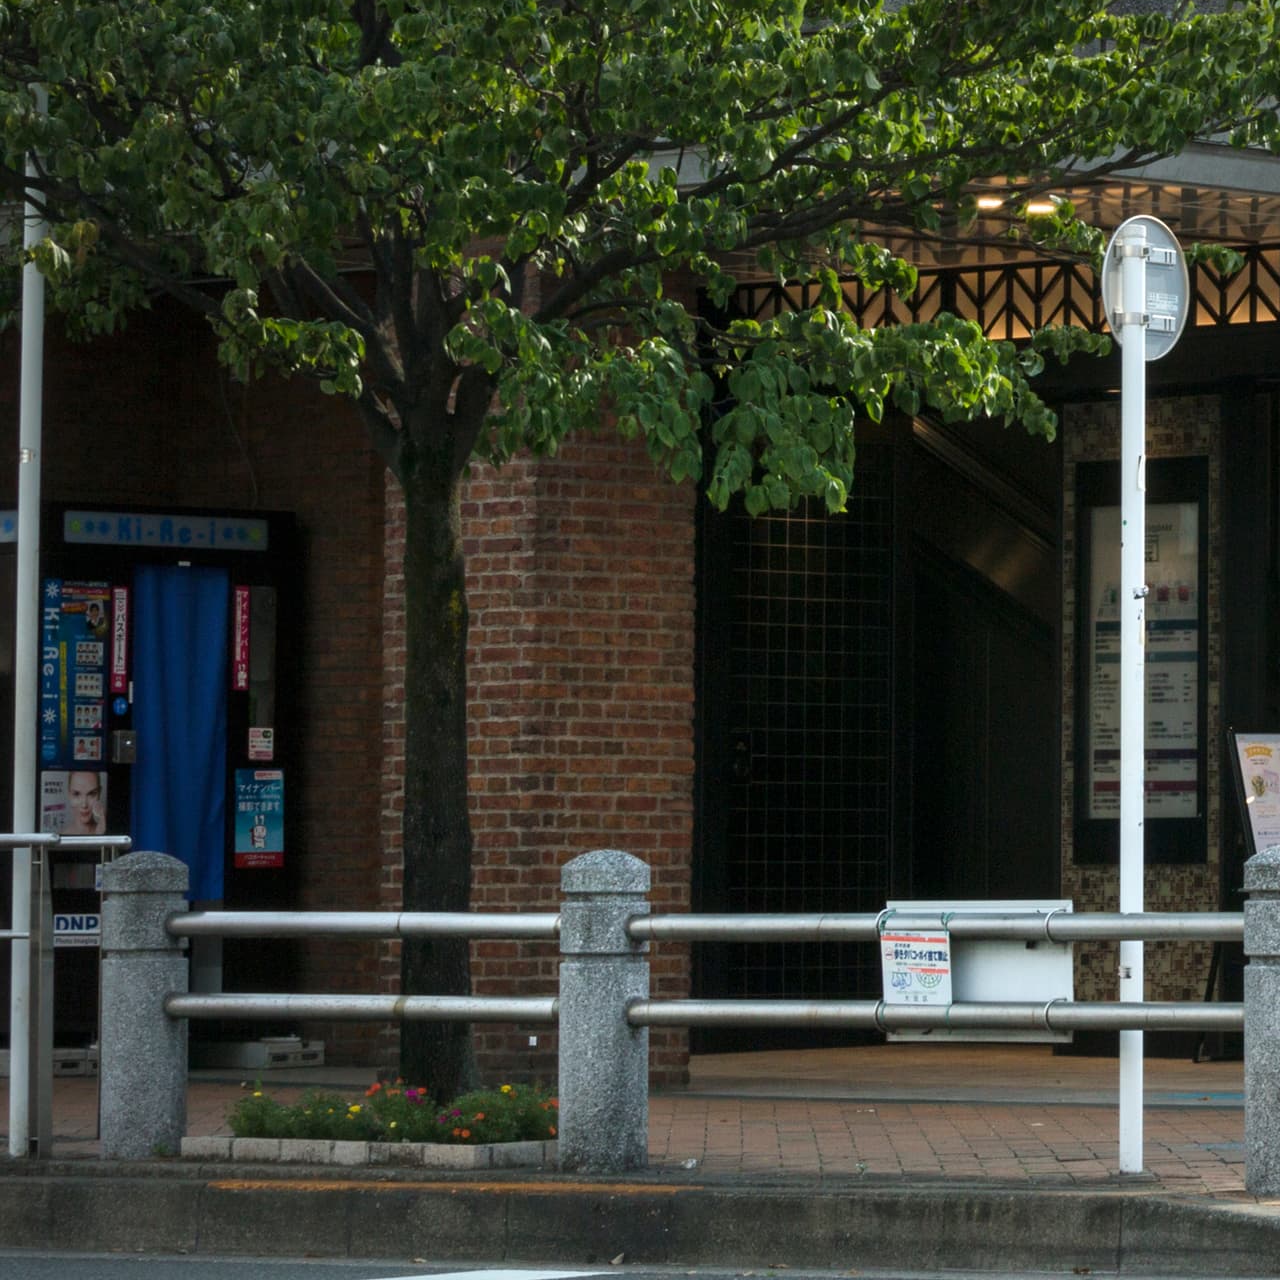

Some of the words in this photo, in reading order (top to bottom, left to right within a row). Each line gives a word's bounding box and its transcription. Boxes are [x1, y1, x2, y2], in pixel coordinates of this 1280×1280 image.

[238, 783, 281, 794] マイナンバー
[55, 916, 99, 931] DNP
